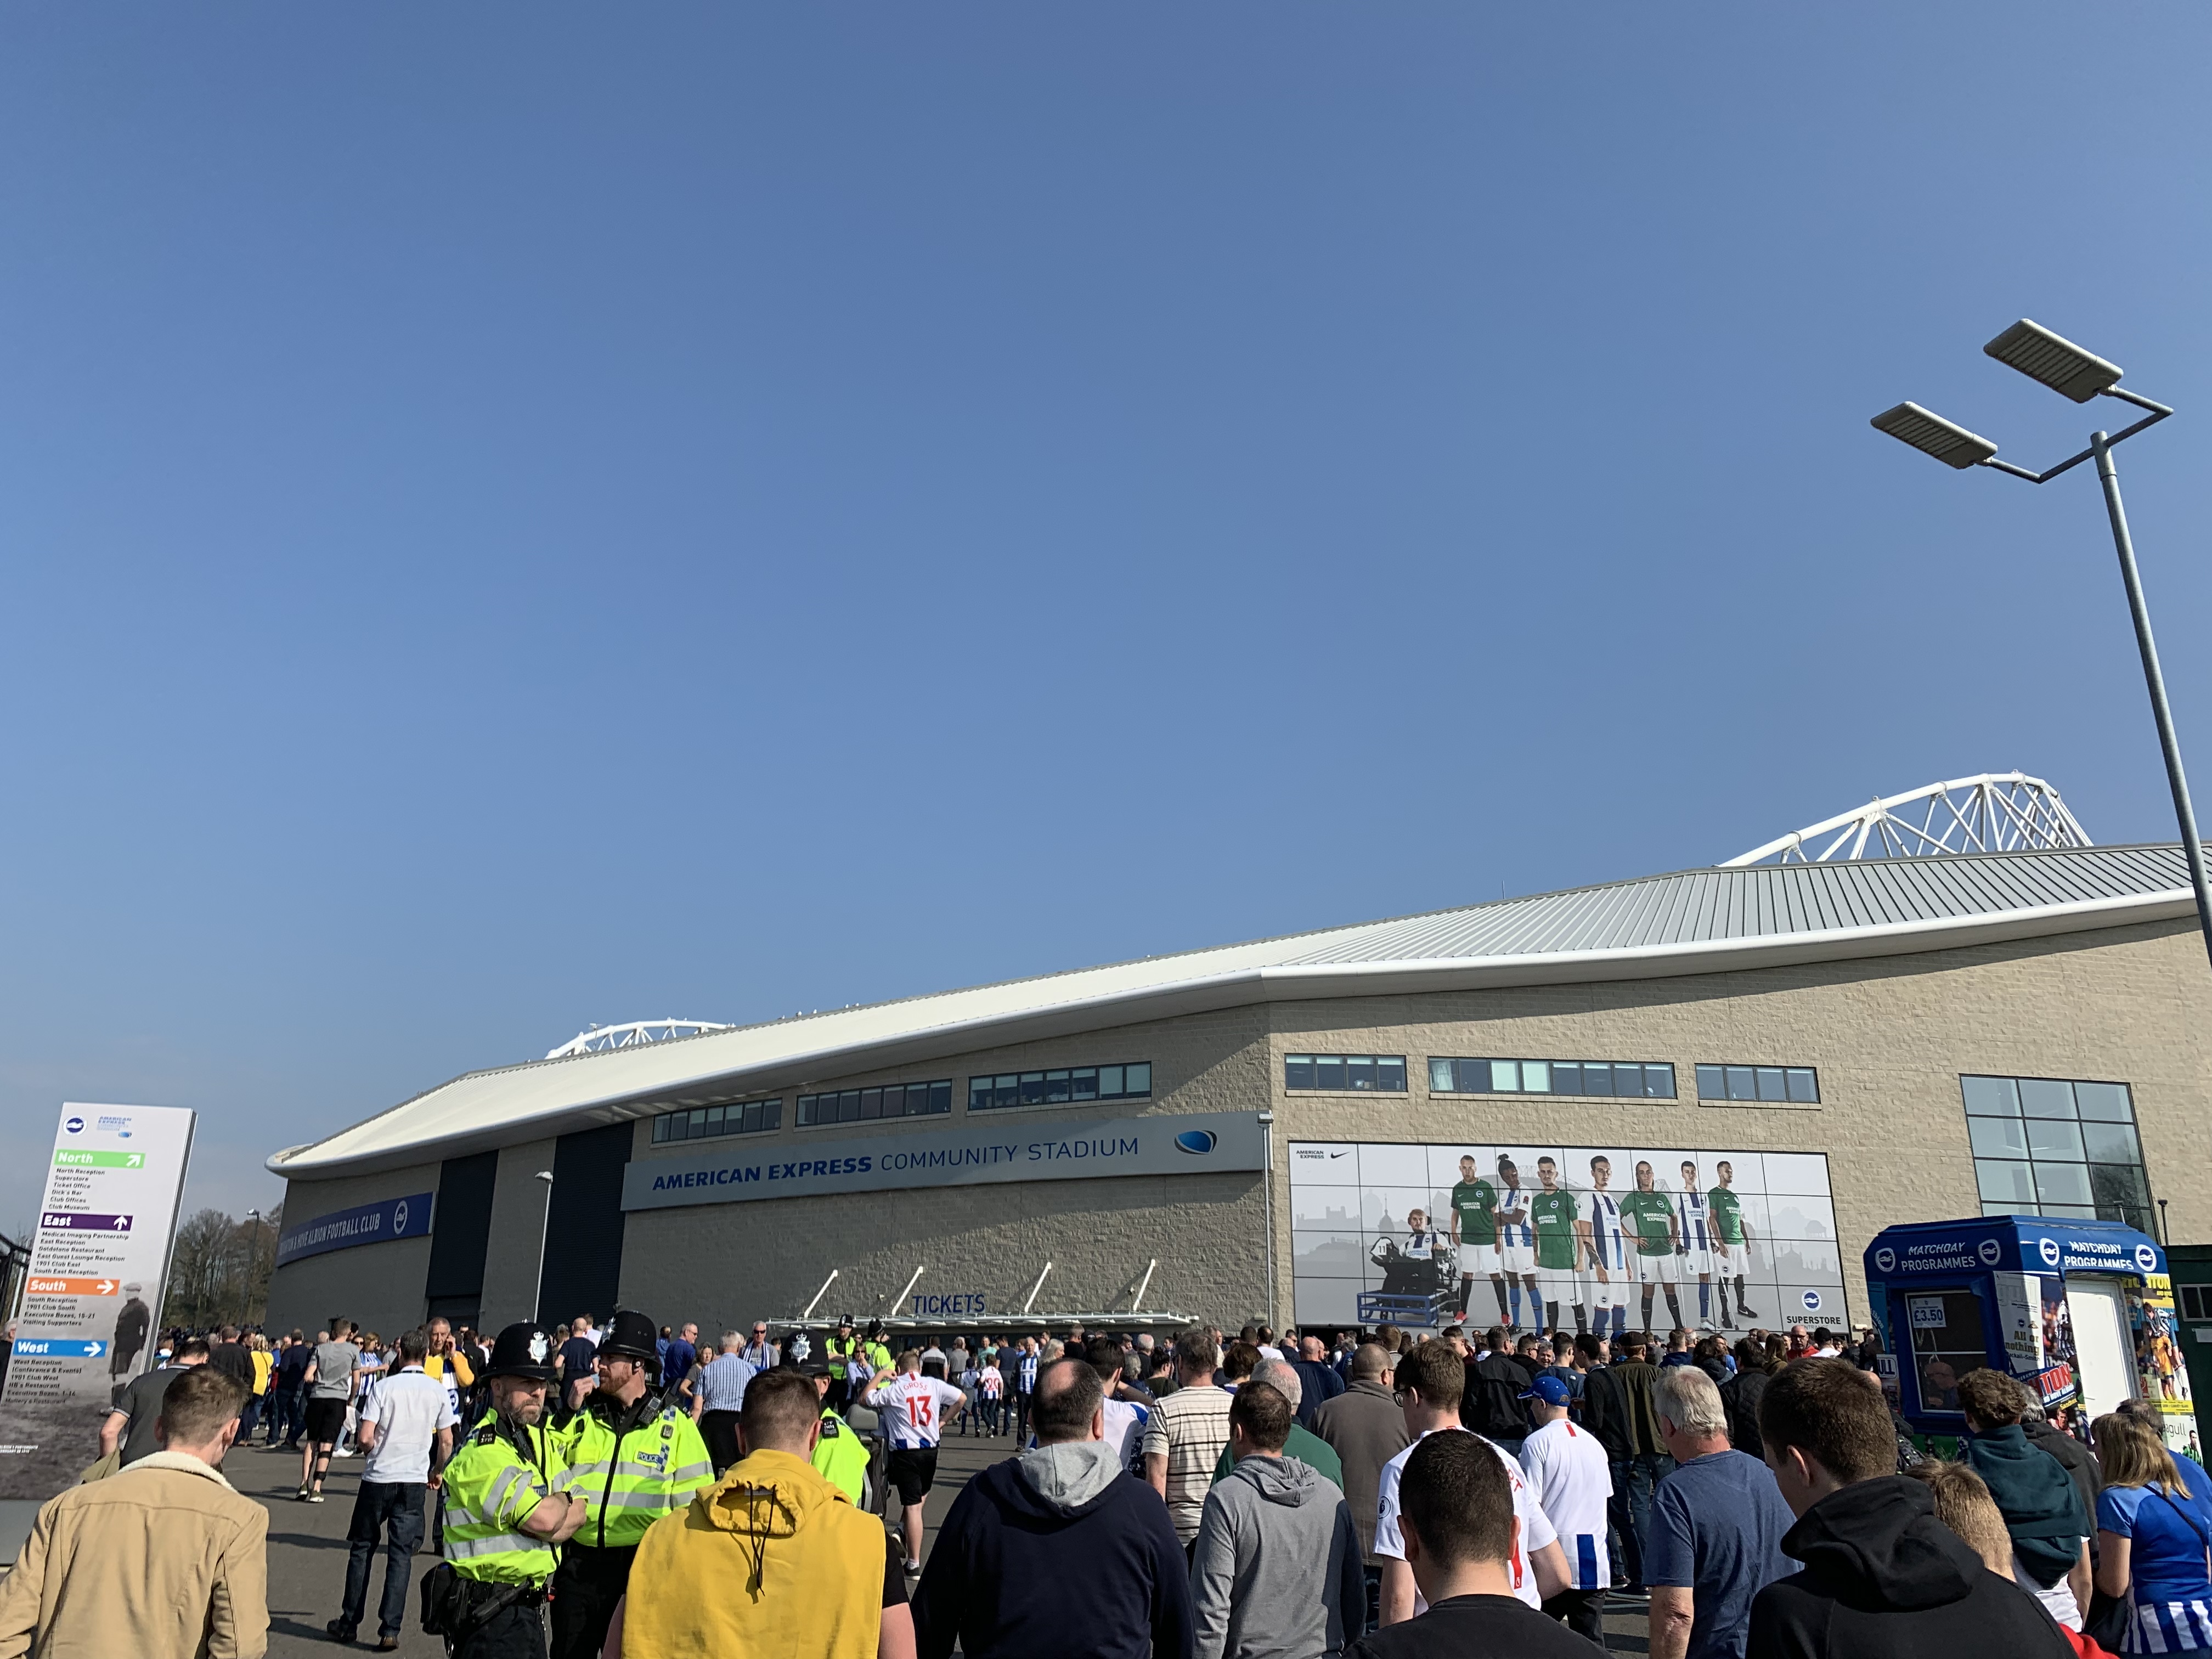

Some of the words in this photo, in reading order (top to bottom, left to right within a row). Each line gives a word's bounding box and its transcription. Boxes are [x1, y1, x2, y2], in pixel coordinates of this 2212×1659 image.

[58, 1152, 94, 1164] North
[652, 1166, 761, 1190] AMERICAN
[769, 1156, 872, 1180] EXPRESS
[881, 1145, 1018, 1171] COMMUNITY
[1029, 1137, 1138, 1161] STADIUM
[43, 1215, 72, 1227] East
[307, 1226, 328, 1245] ALBION
[326, 1217, 359, 1241] FOOTBALL
[360, 1212, 380, 1234] CLUB
[1908, 1242, 1966, 1255] MATCHDAY
[2068, 1241, 2122, 1254] MATCHDAY
[1901, 1256, 1976, 1271] PROGRAMMES
[2063, 1255, 2134, 1270] PROGRAMMES
[30, 1279, 67, 1292] South
[912, 1294, 985, 1313] TICKETS
[1786, 1316, 1841, 1324] SUPERSTORE
[1871, 1308, 1884, 1329] lbion
[1914, 1309, 1943, 1322] £3.50
[2014, 1330, 2027, 1341] All
[18, 1341, 49, 1353] West
[2005, 1341, 2040, 1356] nothing
[904, 1382, 928, 1391] GROSS
[2028, 1364, 2073, 1398] HTON
[906, 1395, 932, 1427] 13
[637, 1452, 659, 1463] POLICE
